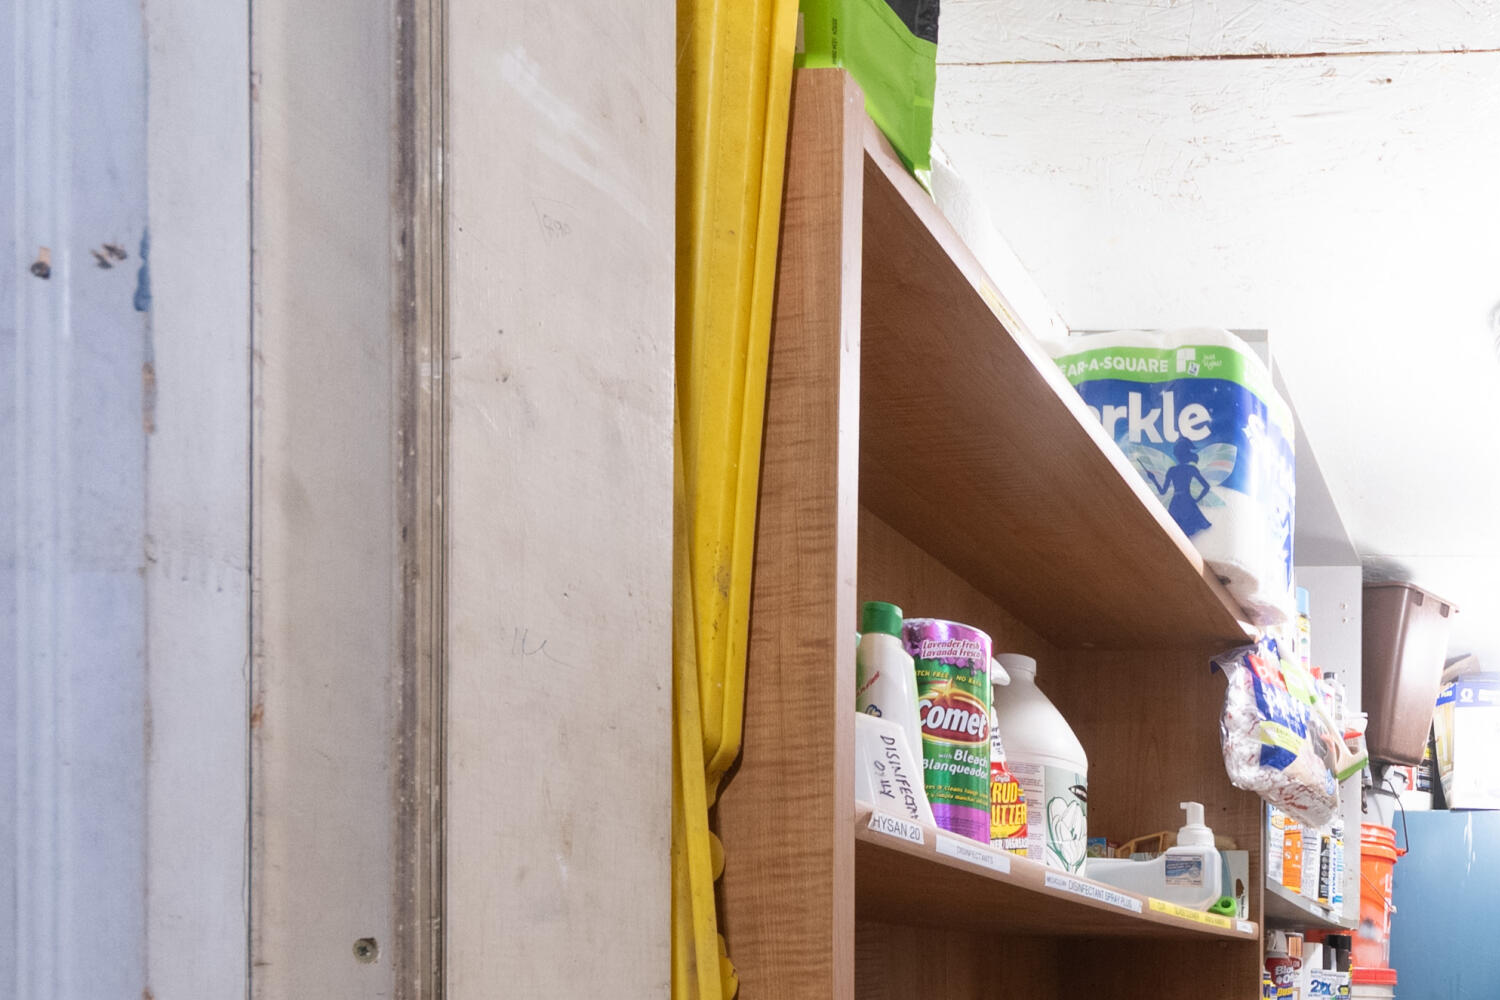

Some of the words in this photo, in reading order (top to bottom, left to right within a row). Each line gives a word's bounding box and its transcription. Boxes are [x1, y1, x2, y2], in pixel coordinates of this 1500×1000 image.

[1061, 357, 1169, 378] EAR-A-SQUARE
[921, 649, 958, 659] Lavanda
[922, 639, 960, 651] Lavender
[919, 699, 989, 739] Comet
[953, 748, 988, 769] Bleach
[990, 803, 1028, 826] UTTER
[872, 816, 909, 838] HYSAN
[909, 826, 921, 841] 20
[1067, 878, 1105, 900] DISINFECTANT
